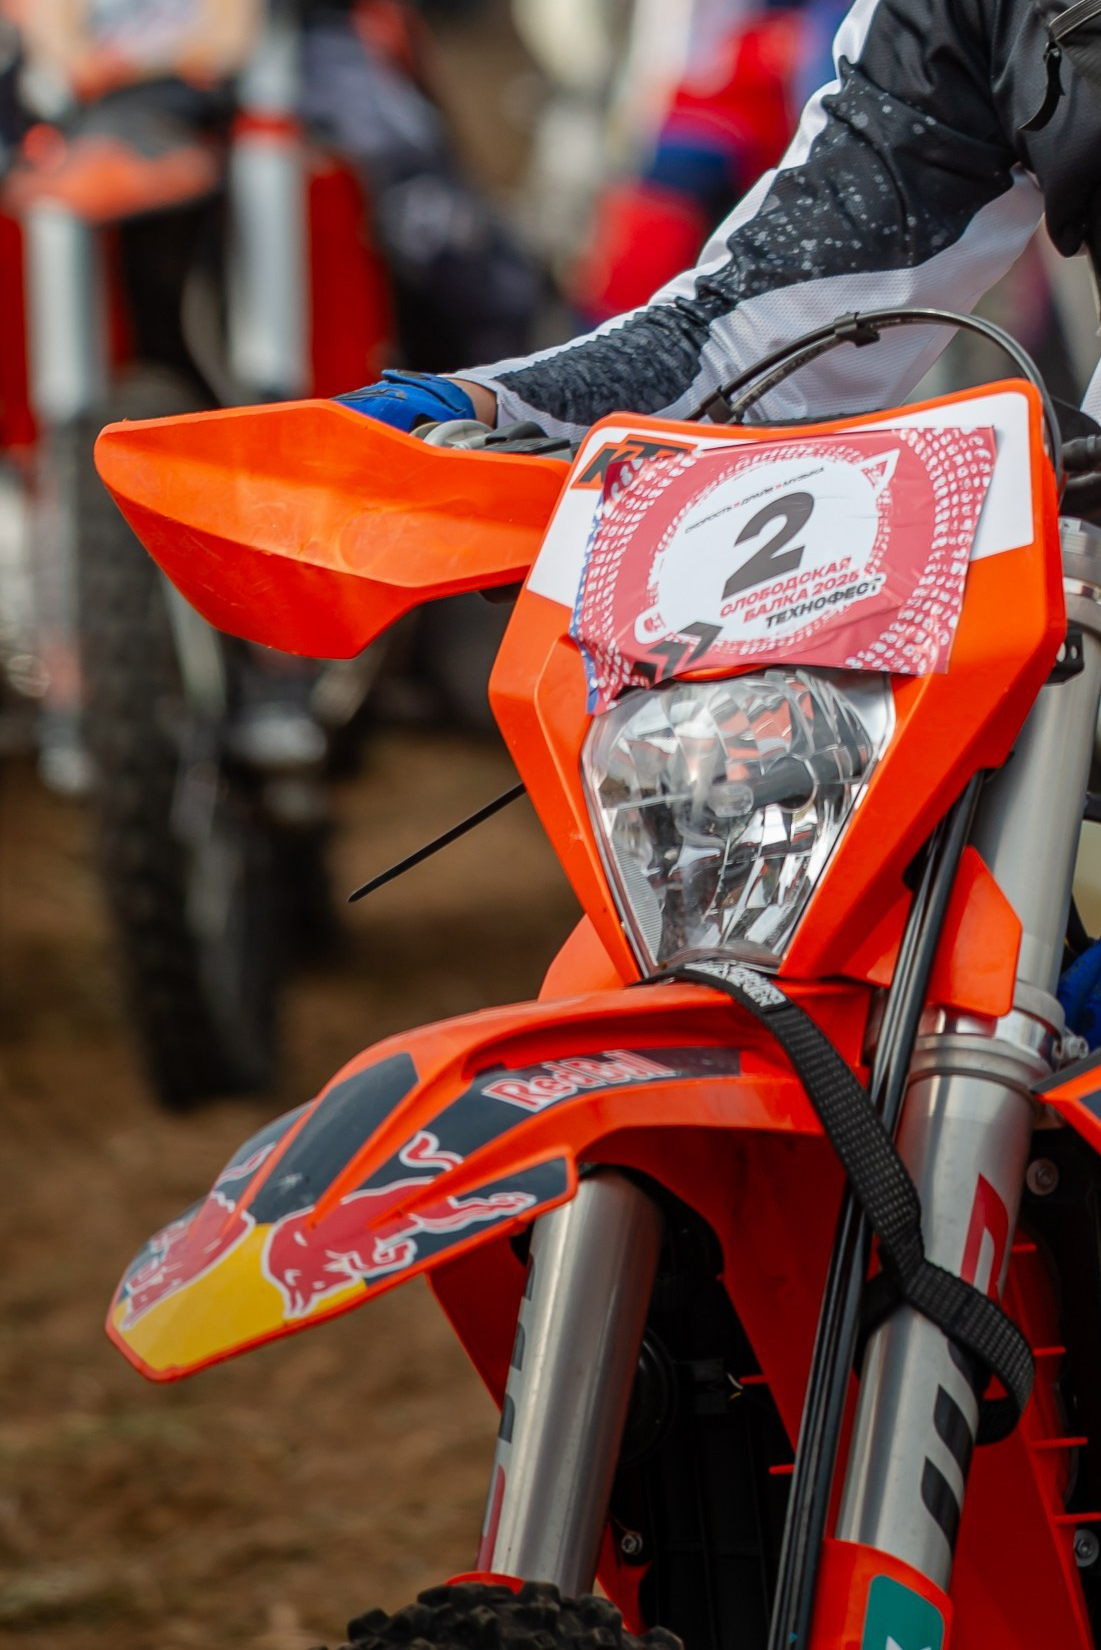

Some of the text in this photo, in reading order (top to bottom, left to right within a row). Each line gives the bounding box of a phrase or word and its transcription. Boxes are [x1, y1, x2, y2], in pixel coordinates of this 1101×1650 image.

[720, 491, 815, 601] 2
[720, 556, 852, 618] СЛОБОДСКАЯ
[743, 568, 859, 623] БАЛКА 2025
[766, 577, 882, 629] ТЕХНОФЕСТ
